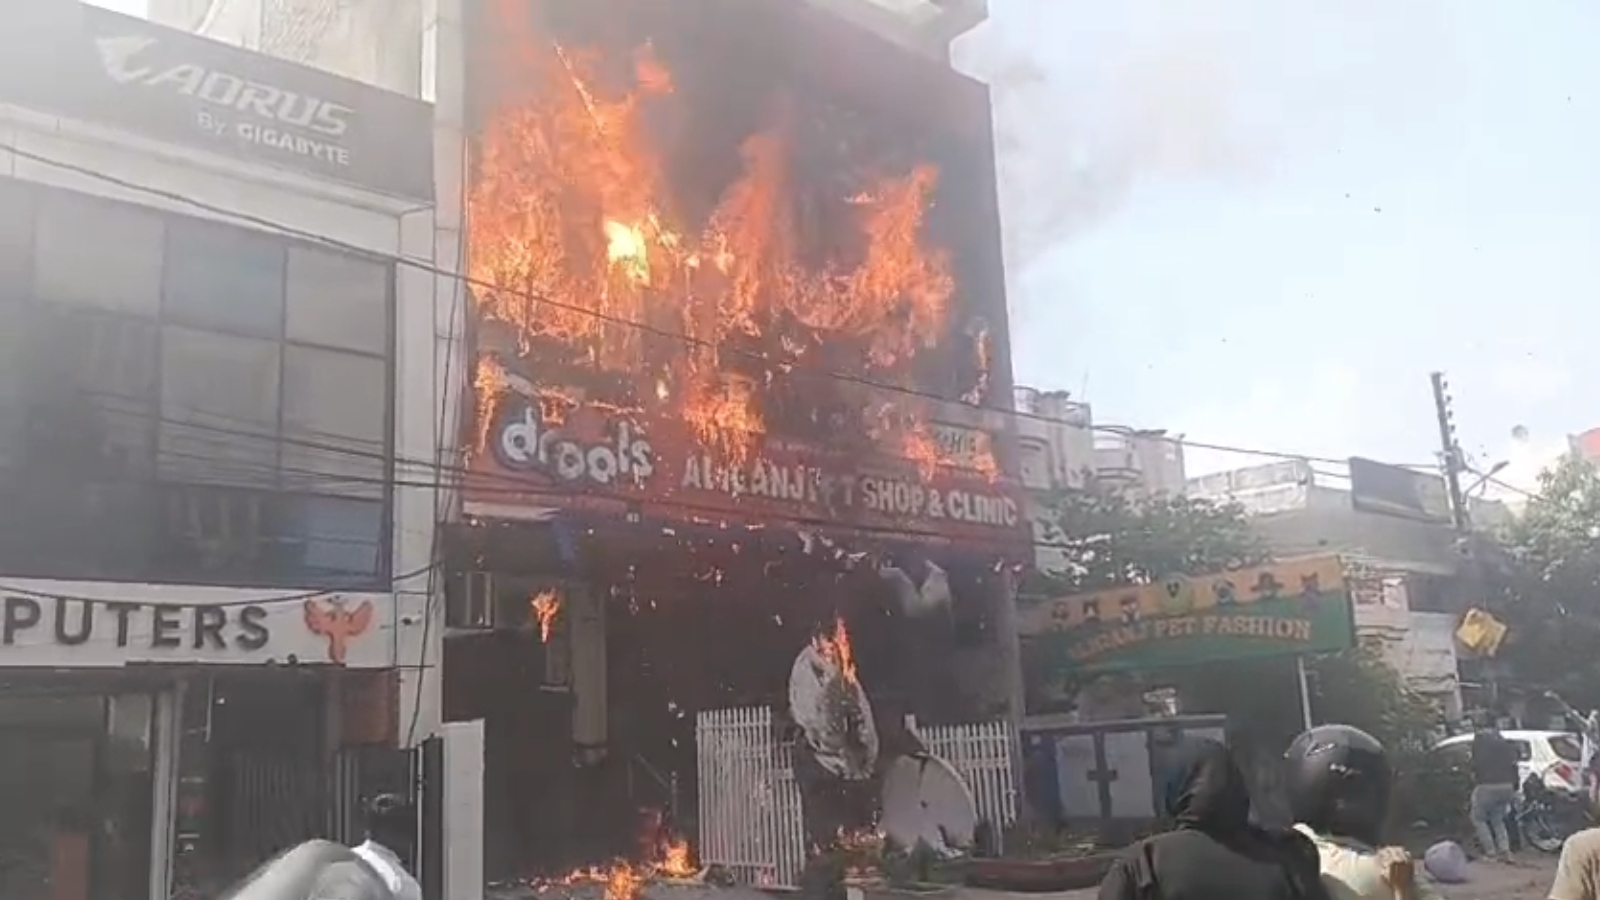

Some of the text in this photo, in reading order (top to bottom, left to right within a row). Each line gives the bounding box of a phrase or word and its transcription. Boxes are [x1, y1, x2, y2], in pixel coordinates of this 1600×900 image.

[144, 64, 356, 136] AORUS
[198, 112, 350, 165] By GIGABYTE
[502, 406, 652, 483] drools
[862, 476, 924, 515] SHOP
[928, 489, 945, 518] &
[948, 490, 1017, 527] CLINIC
[3, 596, 270, 650] PUTERS
[1154, 617, 1196, 638] PET
[1203, 615, 1311, 640] FASHION
